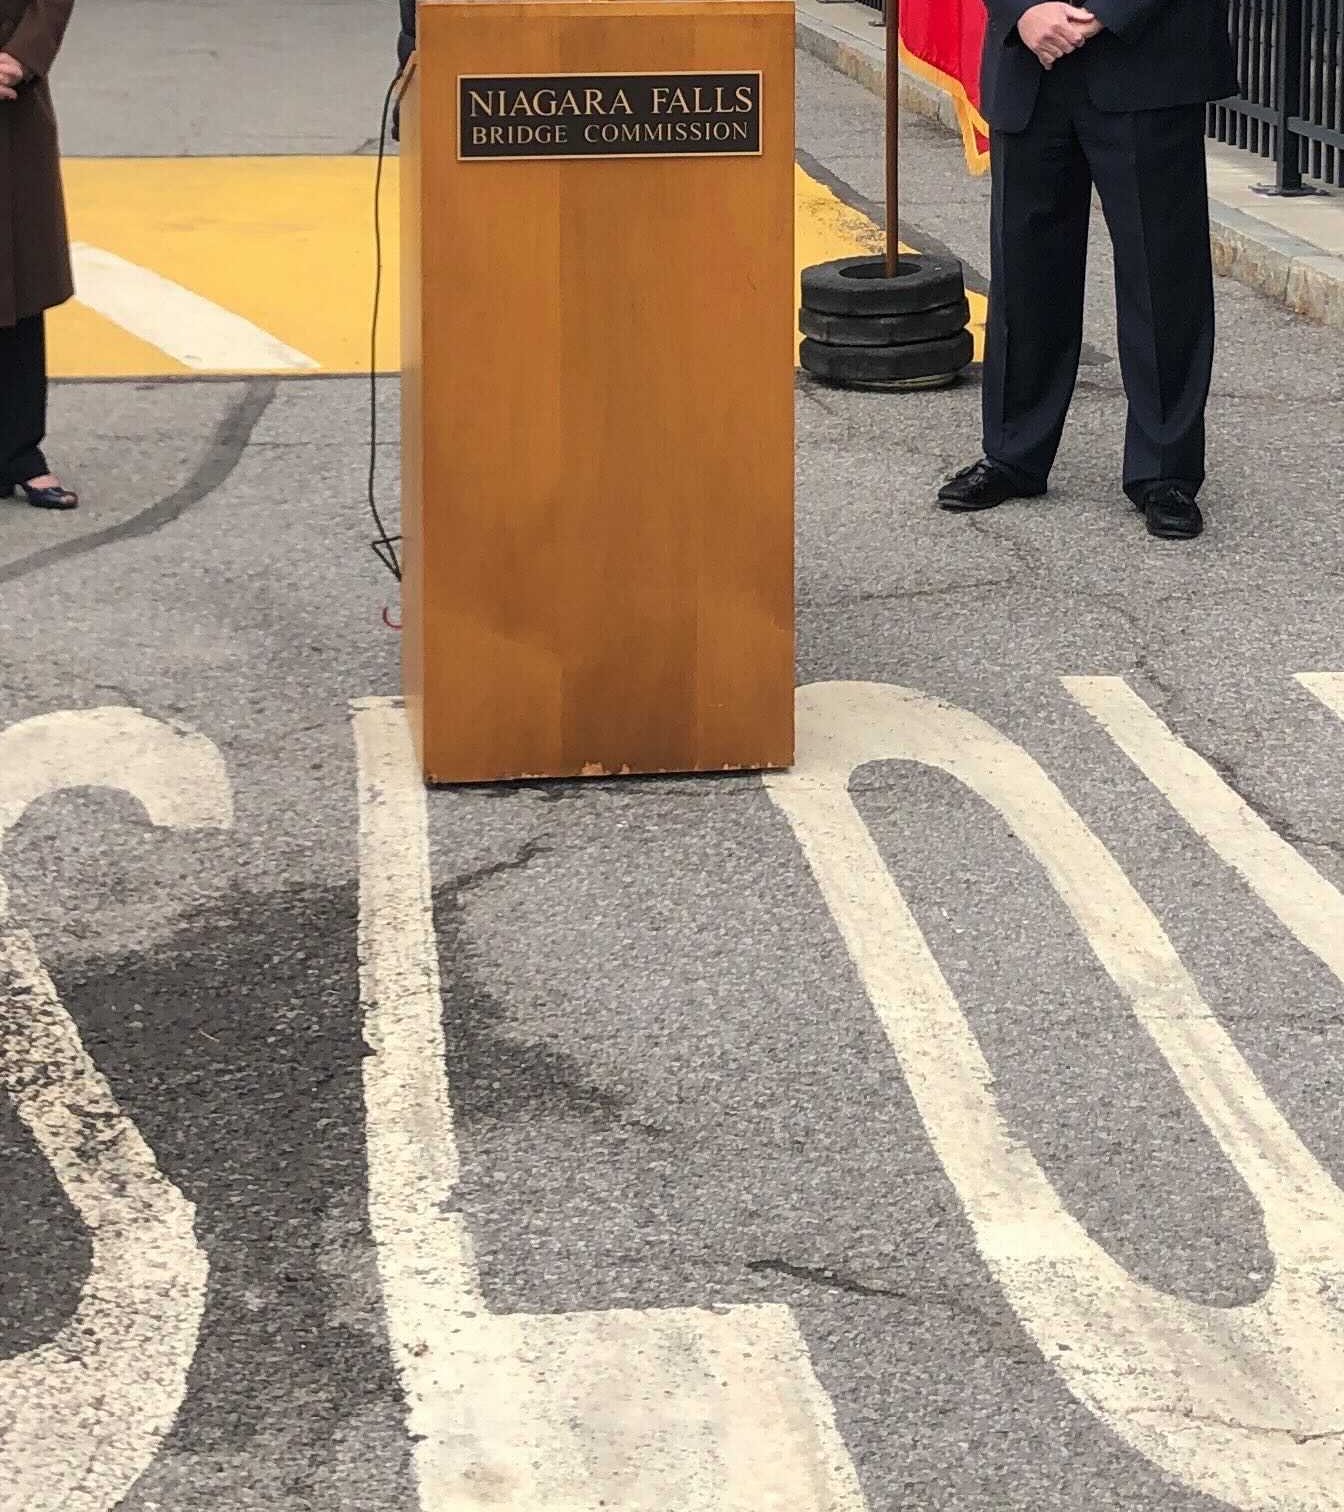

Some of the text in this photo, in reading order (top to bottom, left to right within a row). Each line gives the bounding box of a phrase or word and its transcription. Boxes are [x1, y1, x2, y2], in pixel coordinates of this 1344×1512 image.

[468, 86, 754, 118] NIAGARA FALLS
[472, 121, 748, 145] BRIDGE COMMISSION
